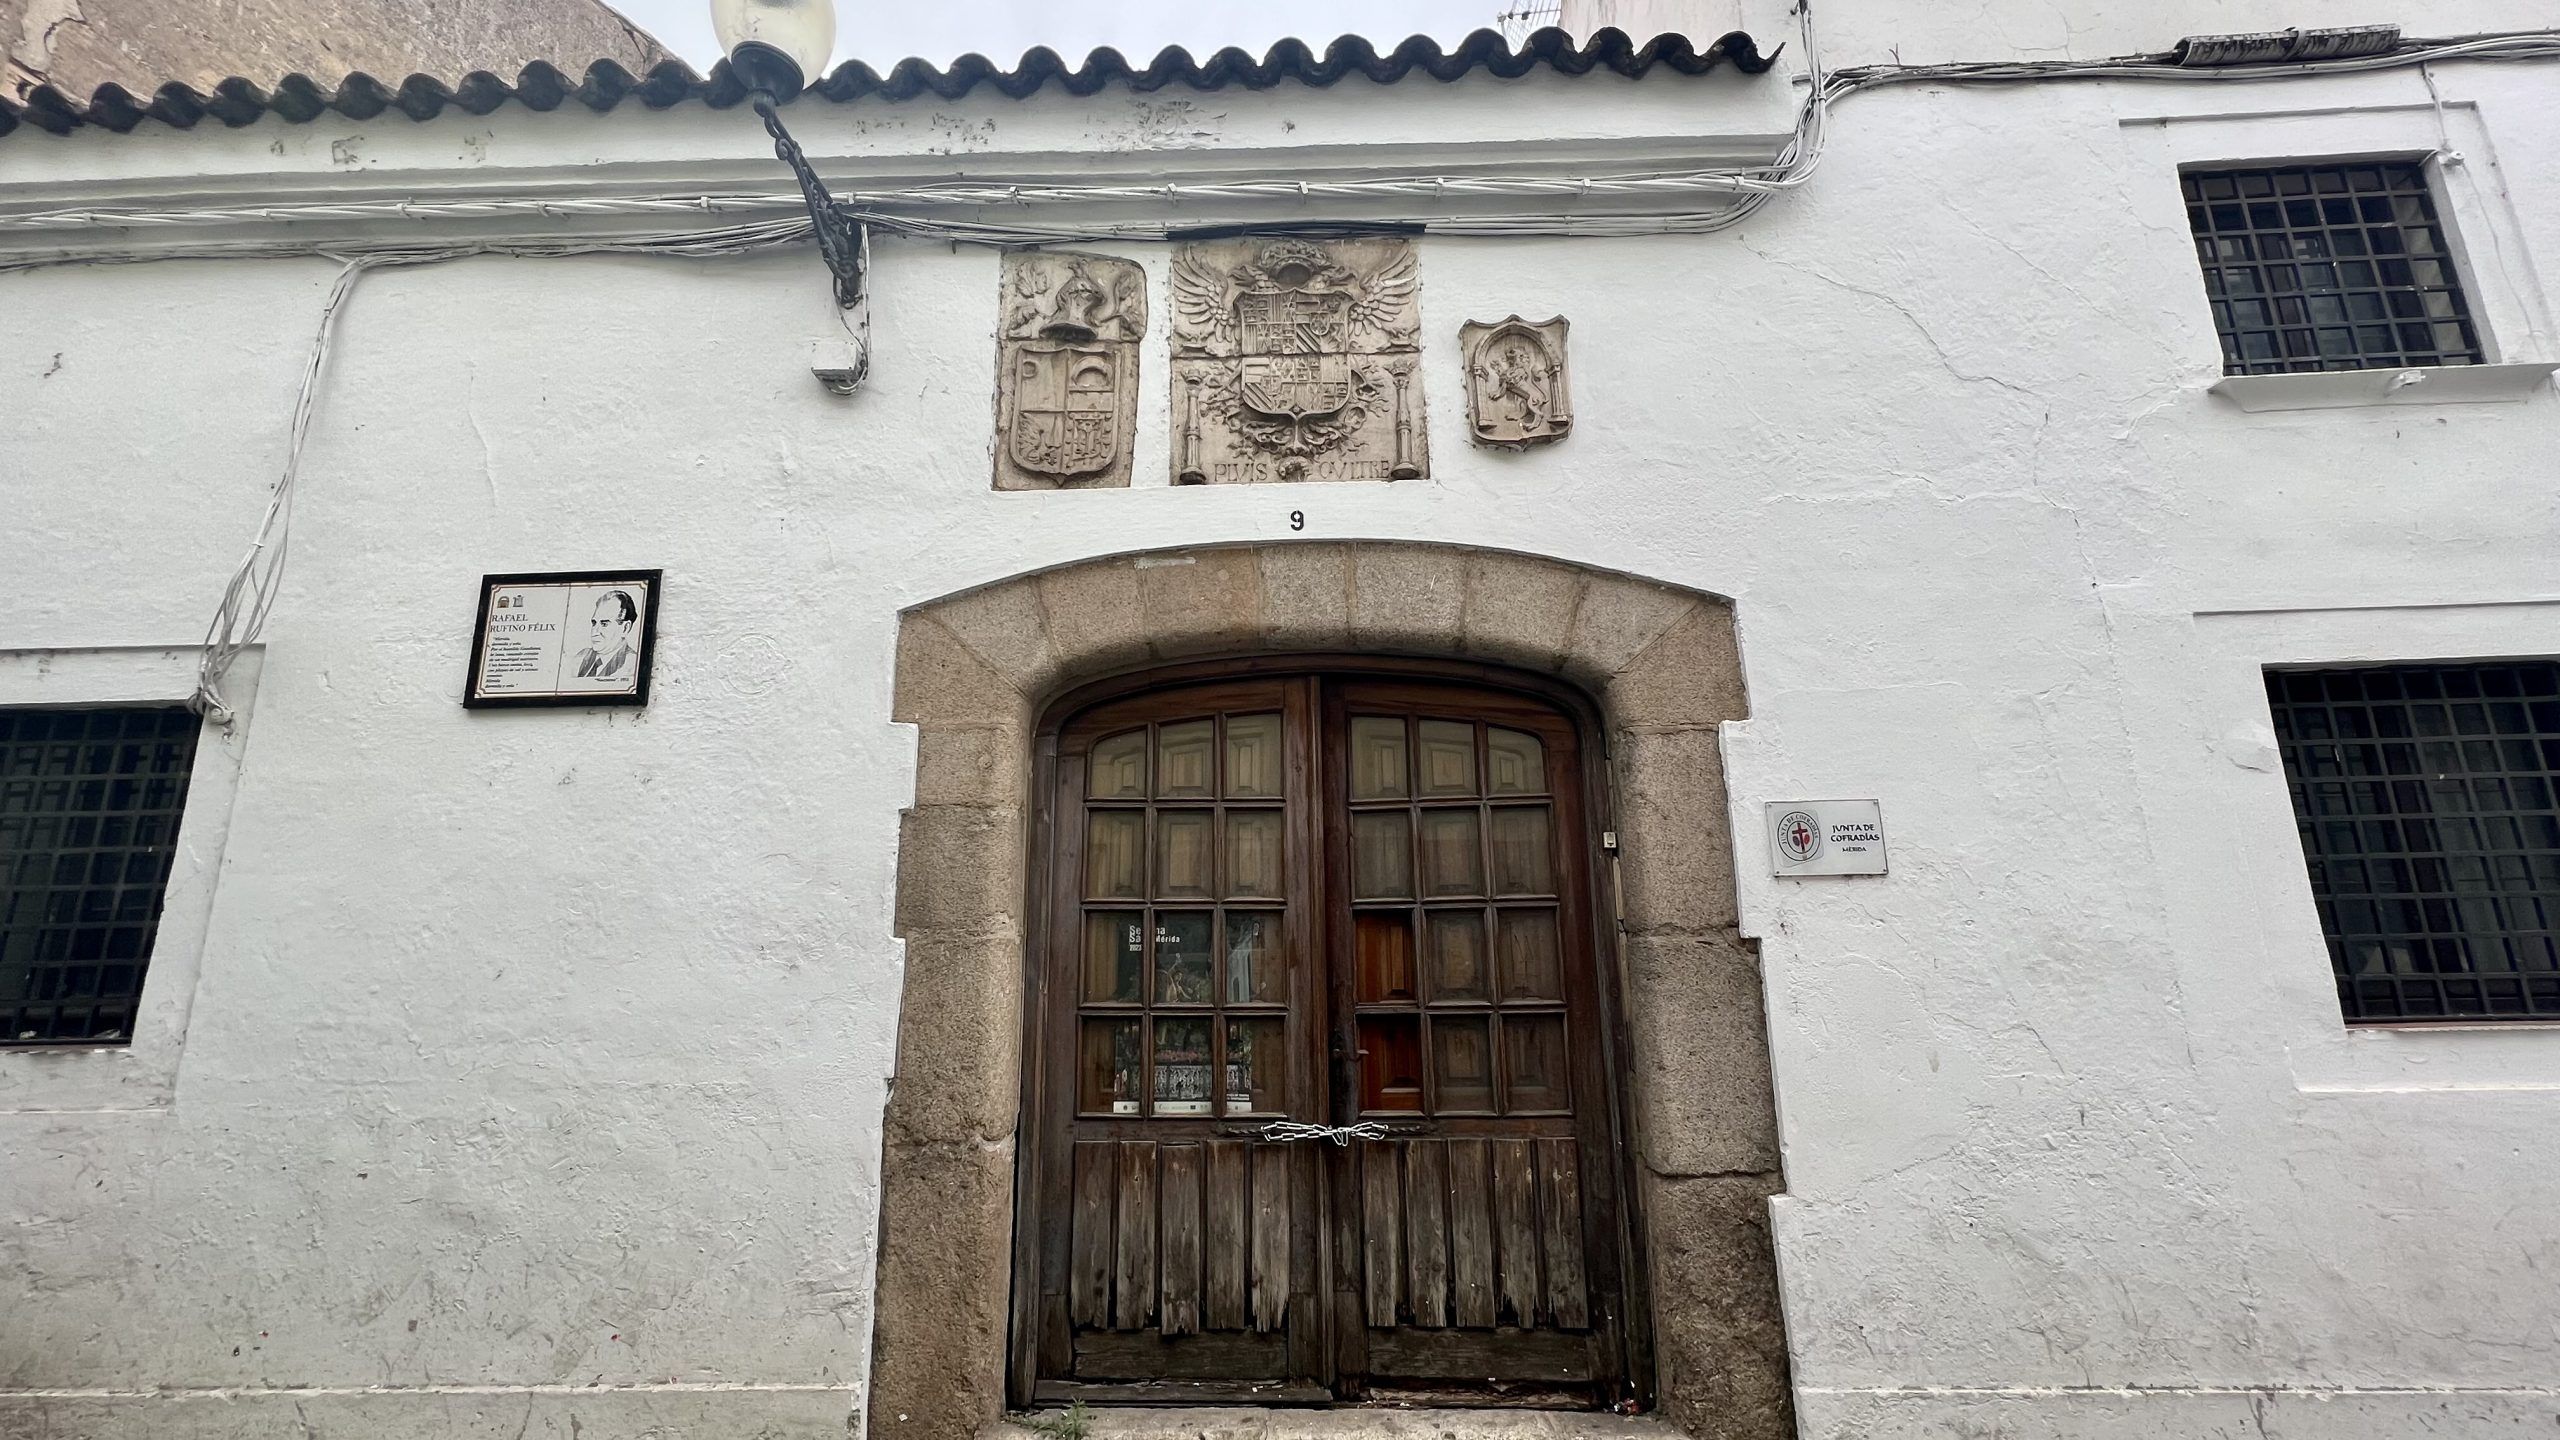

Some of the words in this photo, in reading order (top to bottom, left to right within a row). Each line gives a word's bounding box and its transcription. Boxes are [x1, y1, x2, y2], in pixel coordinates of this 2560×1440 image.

[1290, 510, 1304, 531] 9
[492, 613, 528, 622] RAFAEL
[490, 624, 526, 632] RUFINO
[528, 621, 556, 632] FÉLIX
[1832, 824, 1862, 833] JUNTA
[1830, 833, 1880, 842] COFRADÍAS
